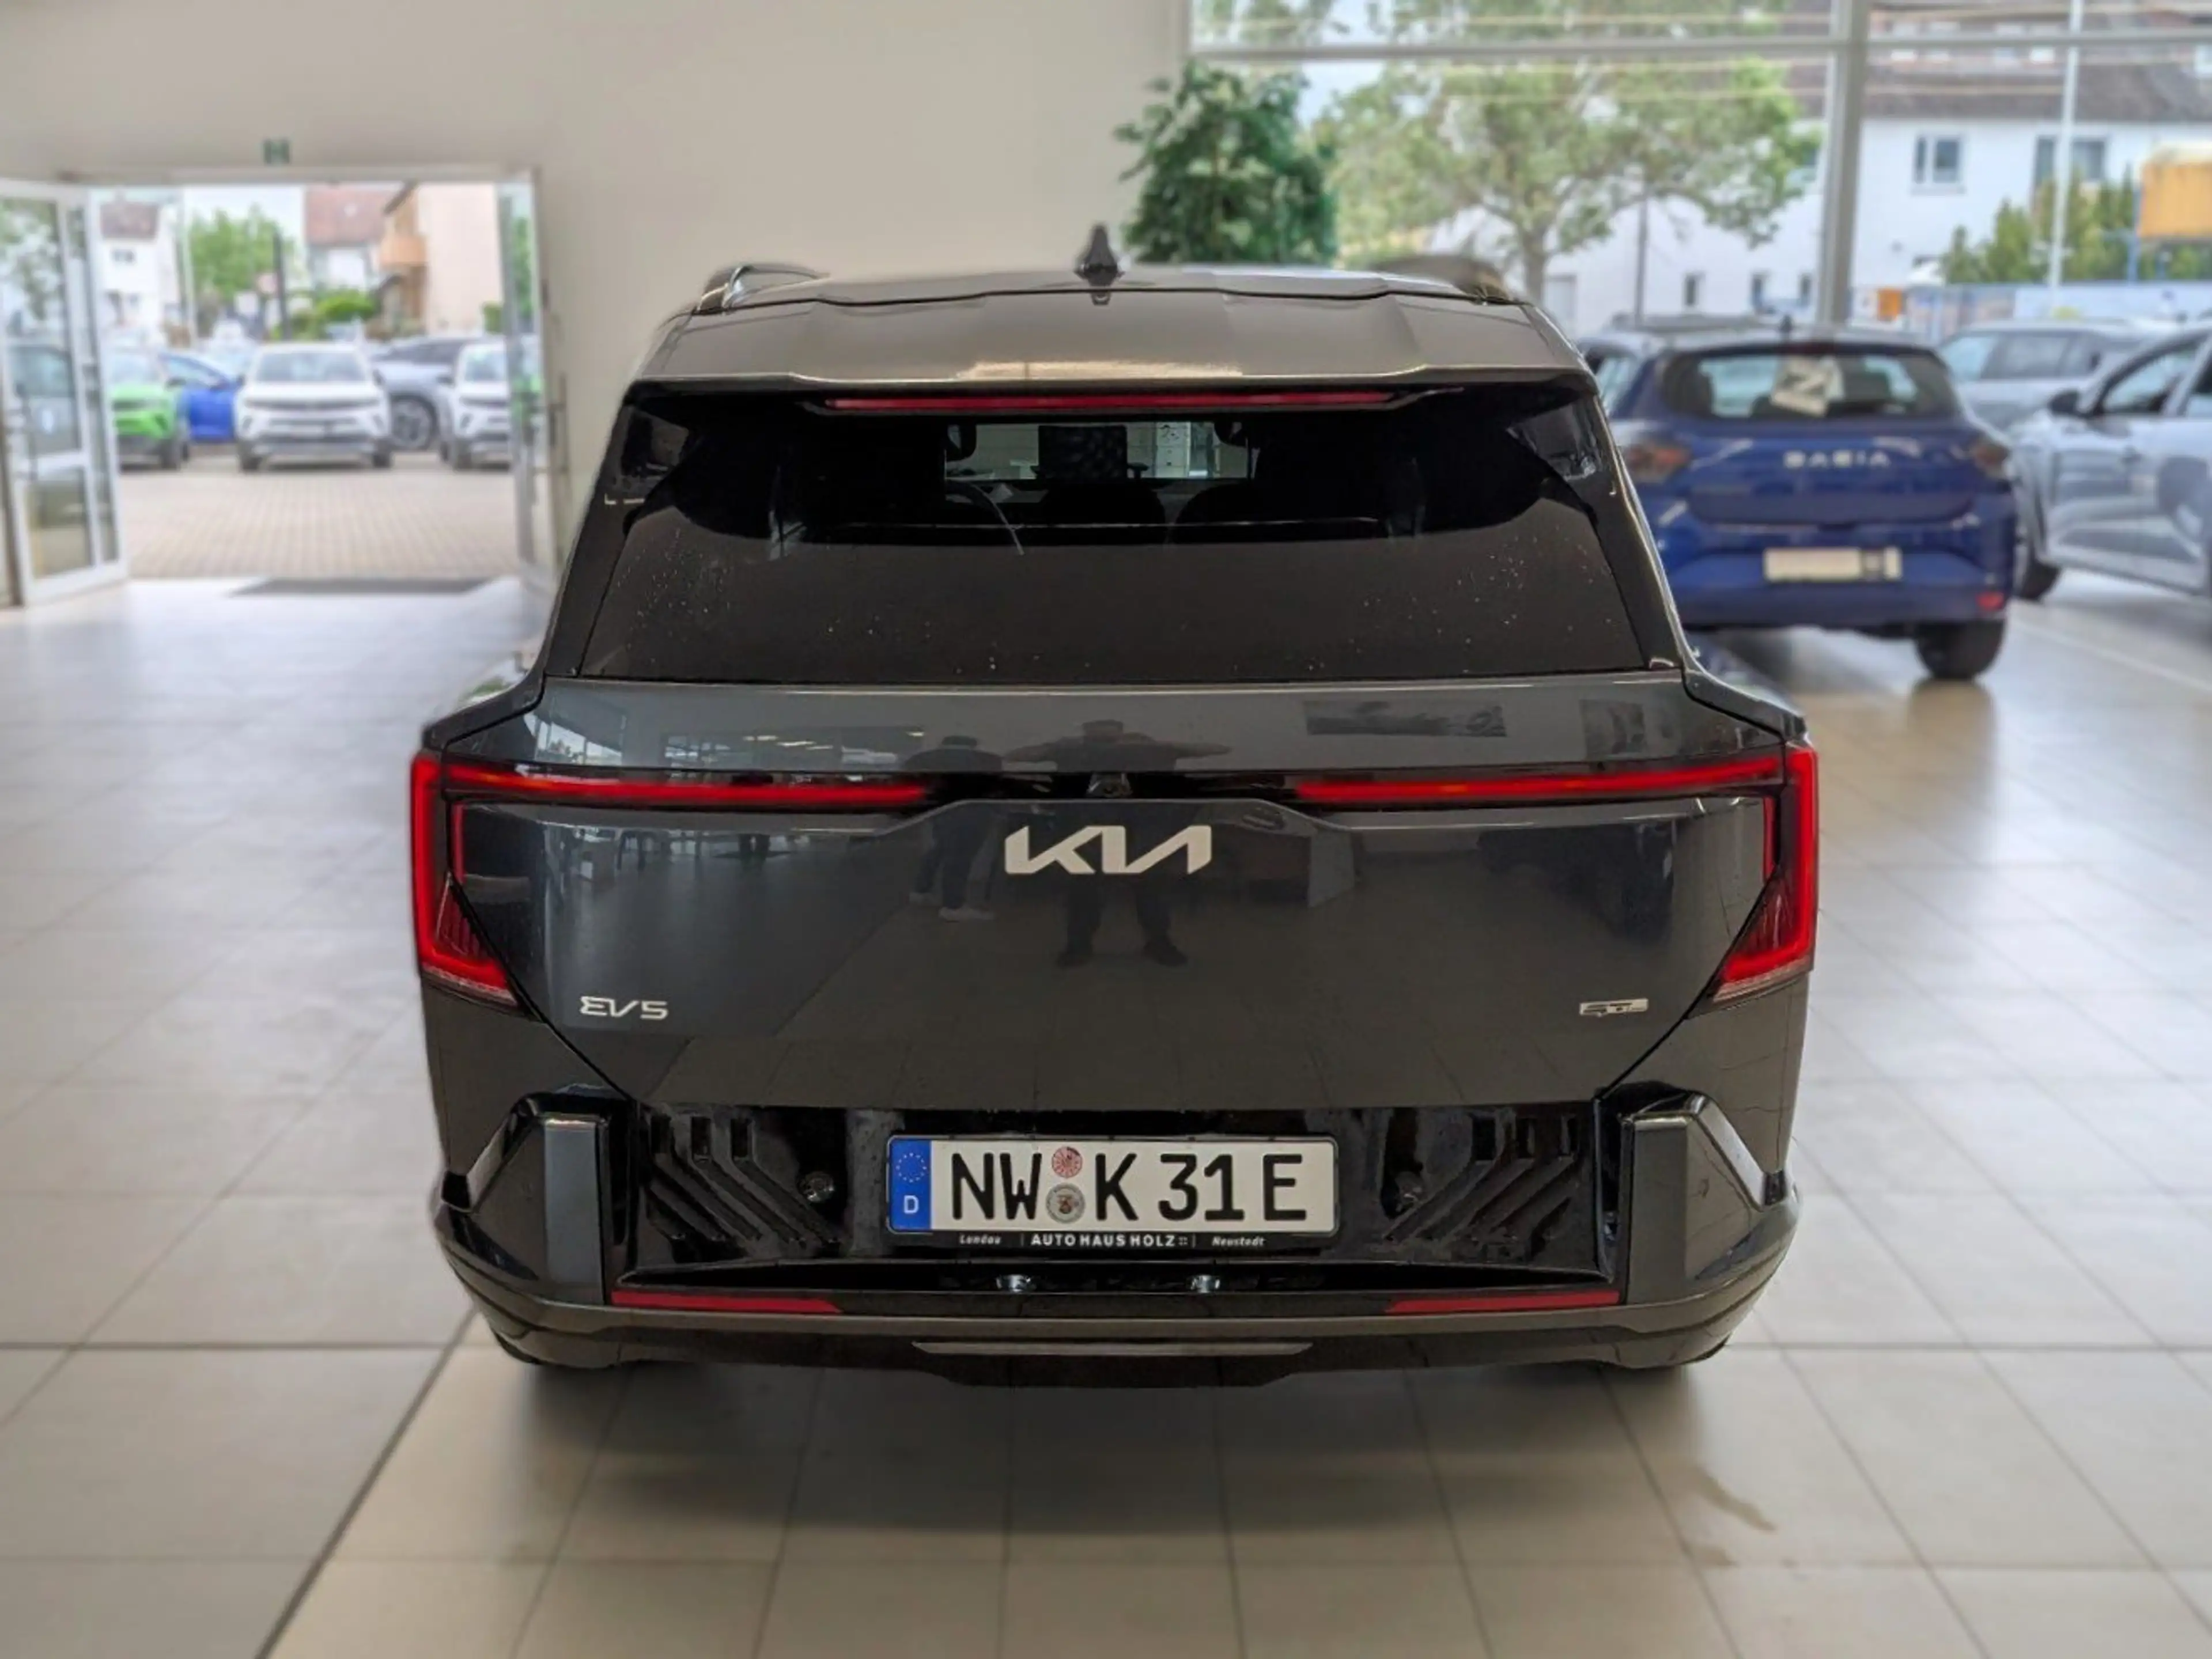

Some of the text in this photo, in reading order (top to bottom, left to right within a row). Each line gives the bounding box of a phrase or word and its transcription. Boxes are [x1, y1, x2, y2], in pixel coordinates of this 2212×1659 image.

[1005, 825, 1211, 874] KIA
[580, 996, 668, 1020] EV5
[951, 1153, 1042, 1221] NW
[1095, 1153, 1139, 1221] K
[903, 1195, 919, 1214] D
[1130, 1234, 1175, 1247] HOLZ
